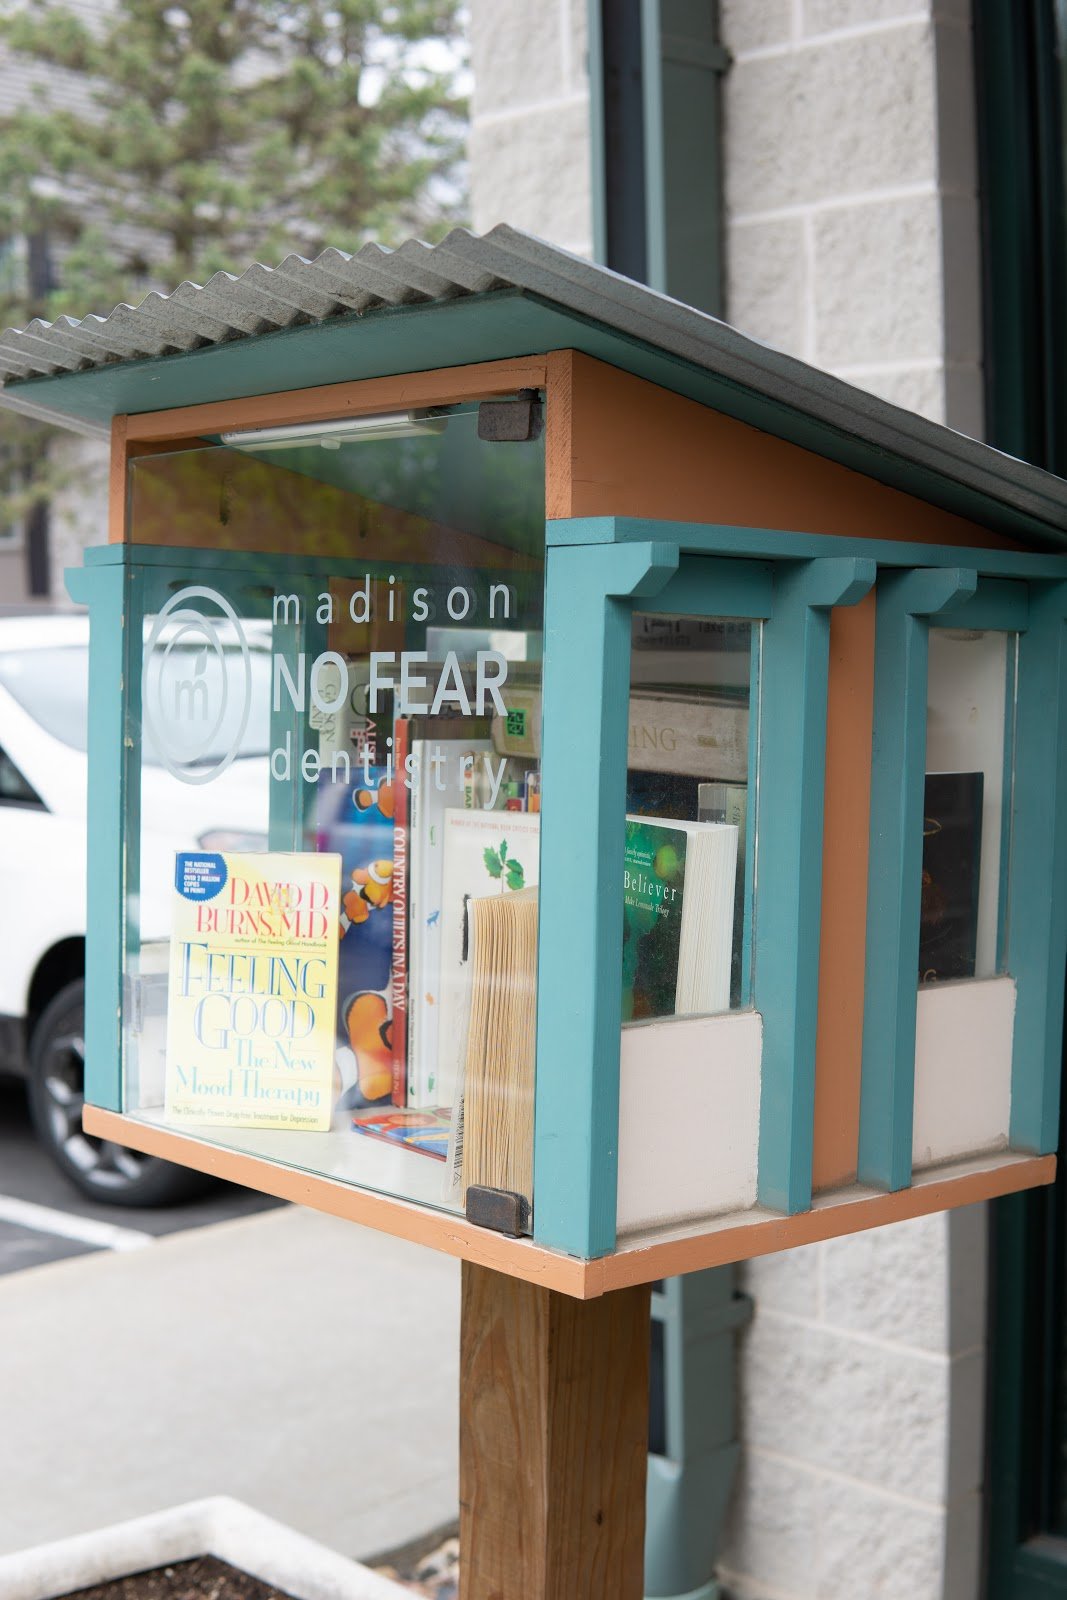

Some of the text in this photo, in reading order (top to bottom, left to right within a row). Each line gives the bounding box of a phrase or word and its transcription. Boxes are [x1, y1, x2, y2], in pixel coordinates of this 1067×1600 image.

[273, 574, 510, 624] madison
[273, 651, 349, 714] NO
[369, 650, 508, 716] FEAR
[271, 730, 506, 809] dentistry
[231, 878, 329, 911] DAVID D.
[624, 870, 677, 901] Believer
[279, 910, 329, 939] M.D.
[393, 827, 406, 1011] COUNTRY QUILTS IN A DAY
[177, 942, 327, 999] FEELING
[194, 993, 315, 1050] GOOD
[234, 1038, 315, 1071] The New
[176, 1065, 320, 1108] Mood Therapy
